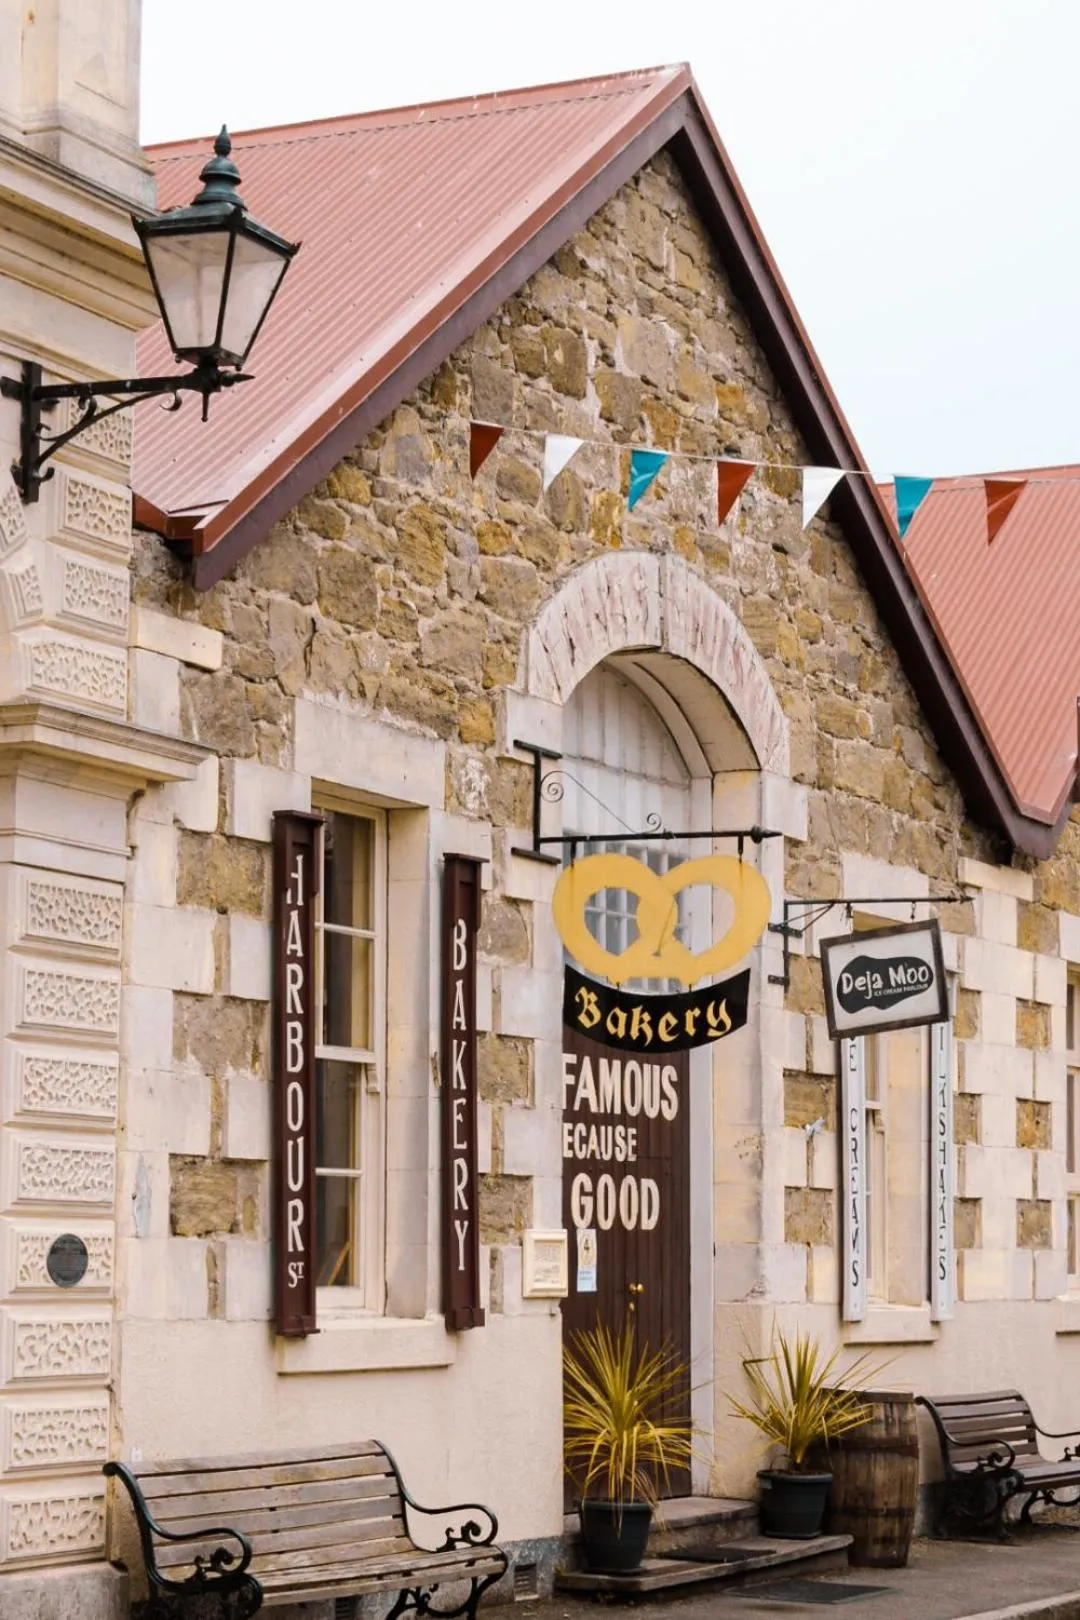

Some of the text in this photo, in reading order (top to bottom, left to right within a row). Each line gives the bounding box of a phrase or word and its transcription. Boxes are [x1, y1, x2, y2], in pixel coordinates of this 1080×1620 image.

[841, 964, 929, 1000] Deja Moo
[574, 986, 732, 1047] Bakery
[286, 854, 304, 1253] HARBOUR
[453, 918, 469, 1271] BAKERY
[561, 1052, 679, 1121] FAMOUS
[562, 1122, 637, 1162] ECAUSE
[571, 1172, 661, 1232] GOOD
